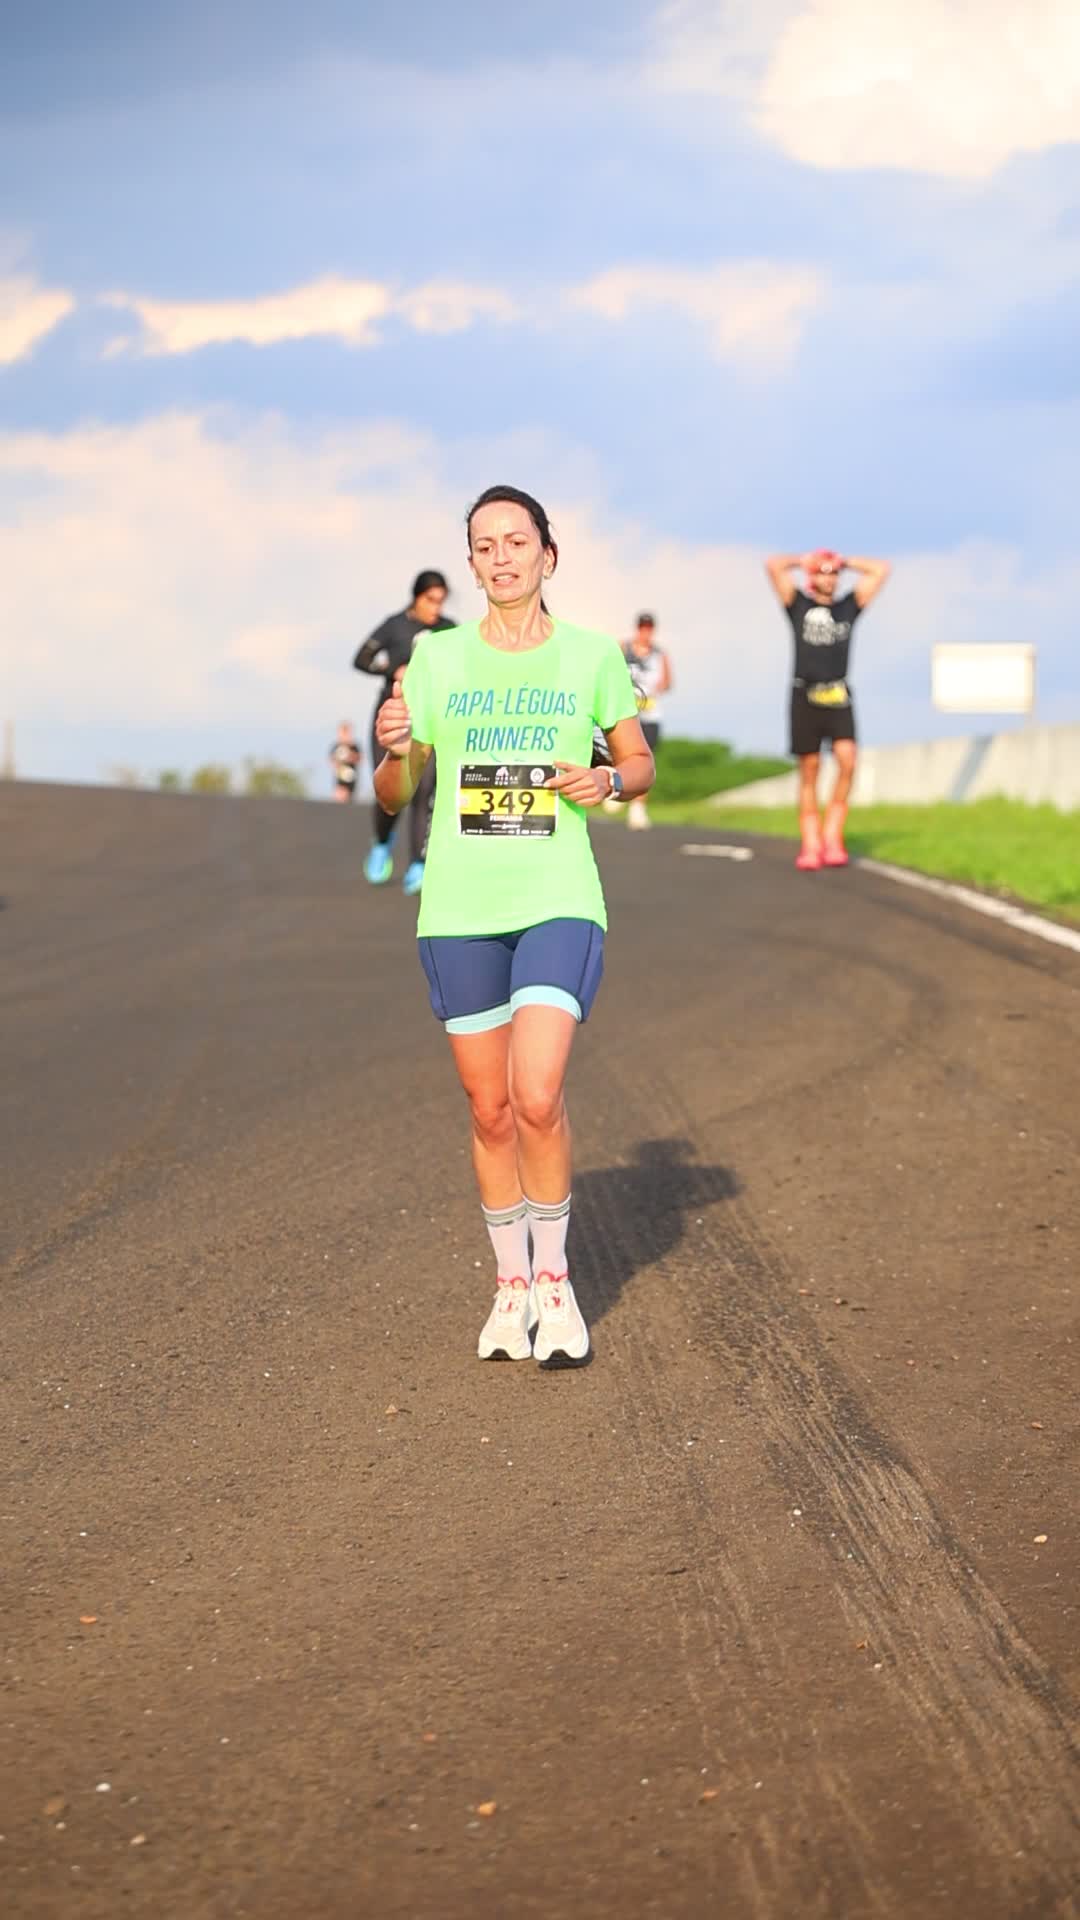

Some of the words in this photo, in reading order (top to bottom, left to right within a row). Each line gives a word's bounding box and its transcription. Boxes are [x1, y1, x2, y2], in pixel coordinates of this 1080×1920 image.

[445, 682, 577, 719] PAPA-LÉGUAS
[466, 726, 558, 753] RUNNERS
[480, 790, 535, 815] 349
